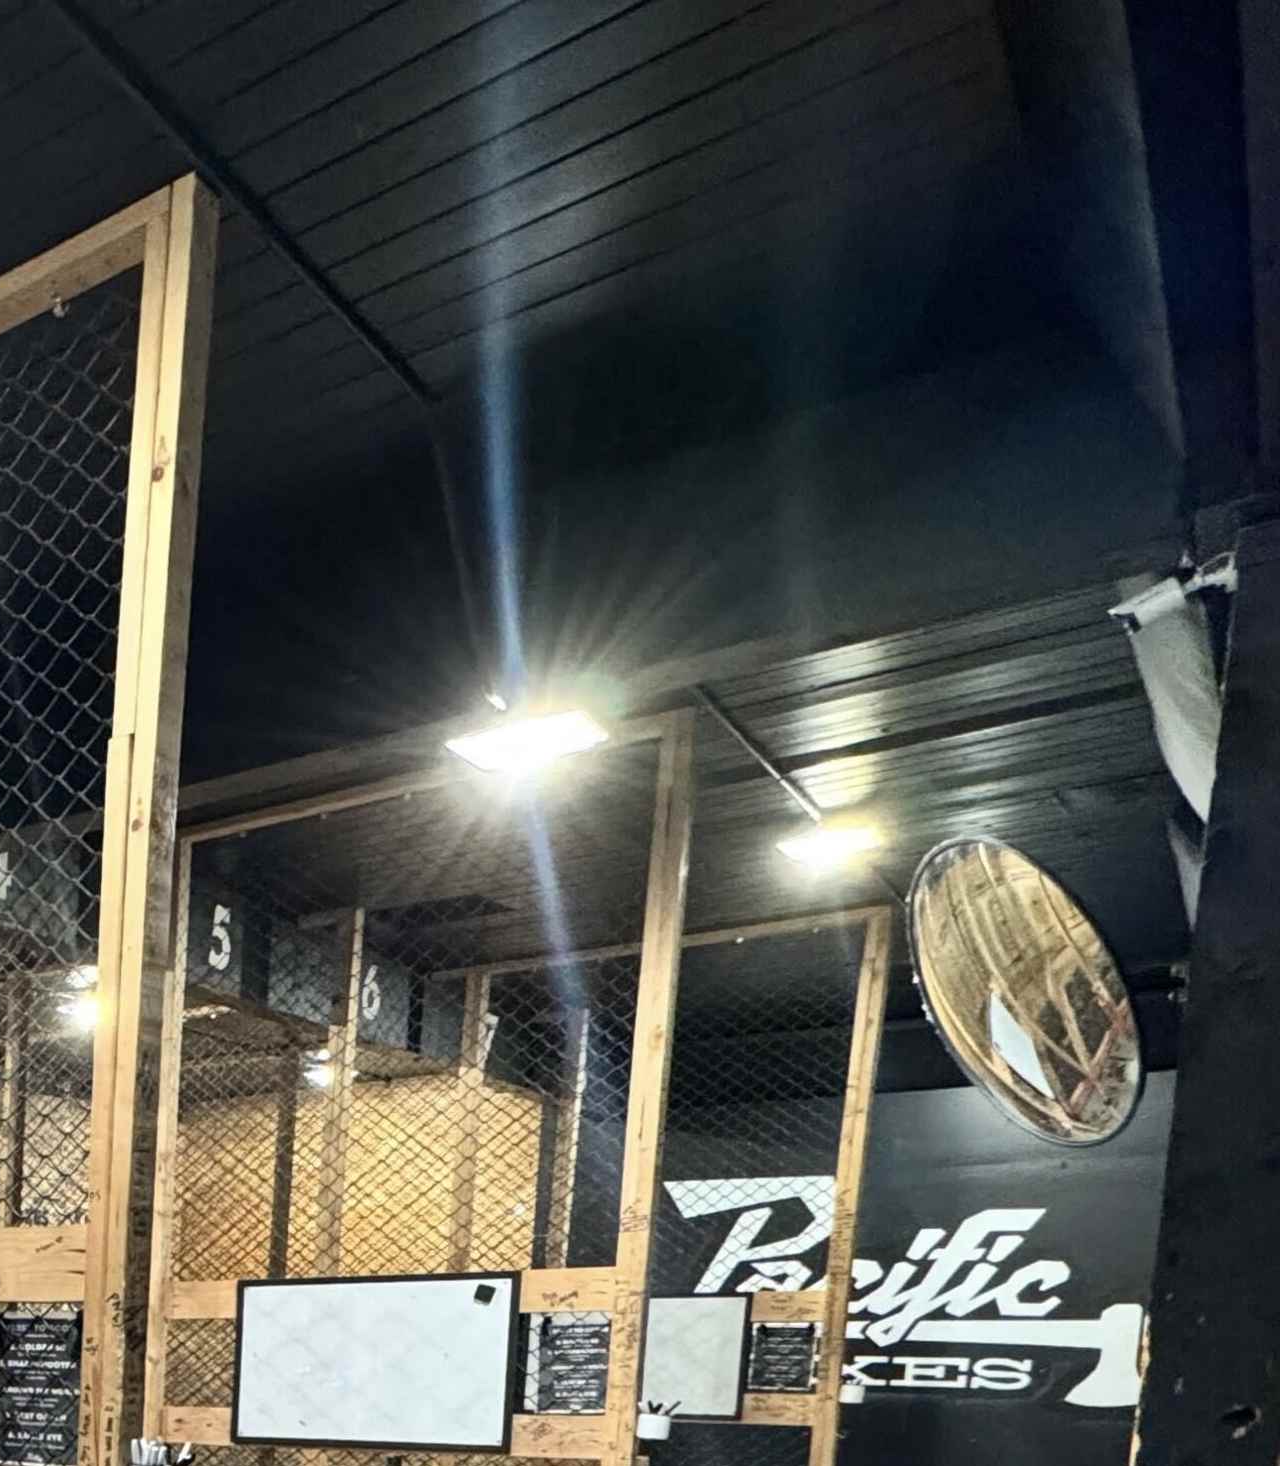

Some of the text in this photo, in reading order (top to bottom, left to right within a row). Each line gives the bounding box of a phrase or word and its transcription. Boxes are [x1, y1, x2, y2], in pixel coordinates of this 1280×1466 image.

[207, 905, 233, 971] 5
[362, 964, 381, 1020] 6
[663, 1176, 1071, 1347] Pacific
[842, 1356, 1033, 1391] XES
